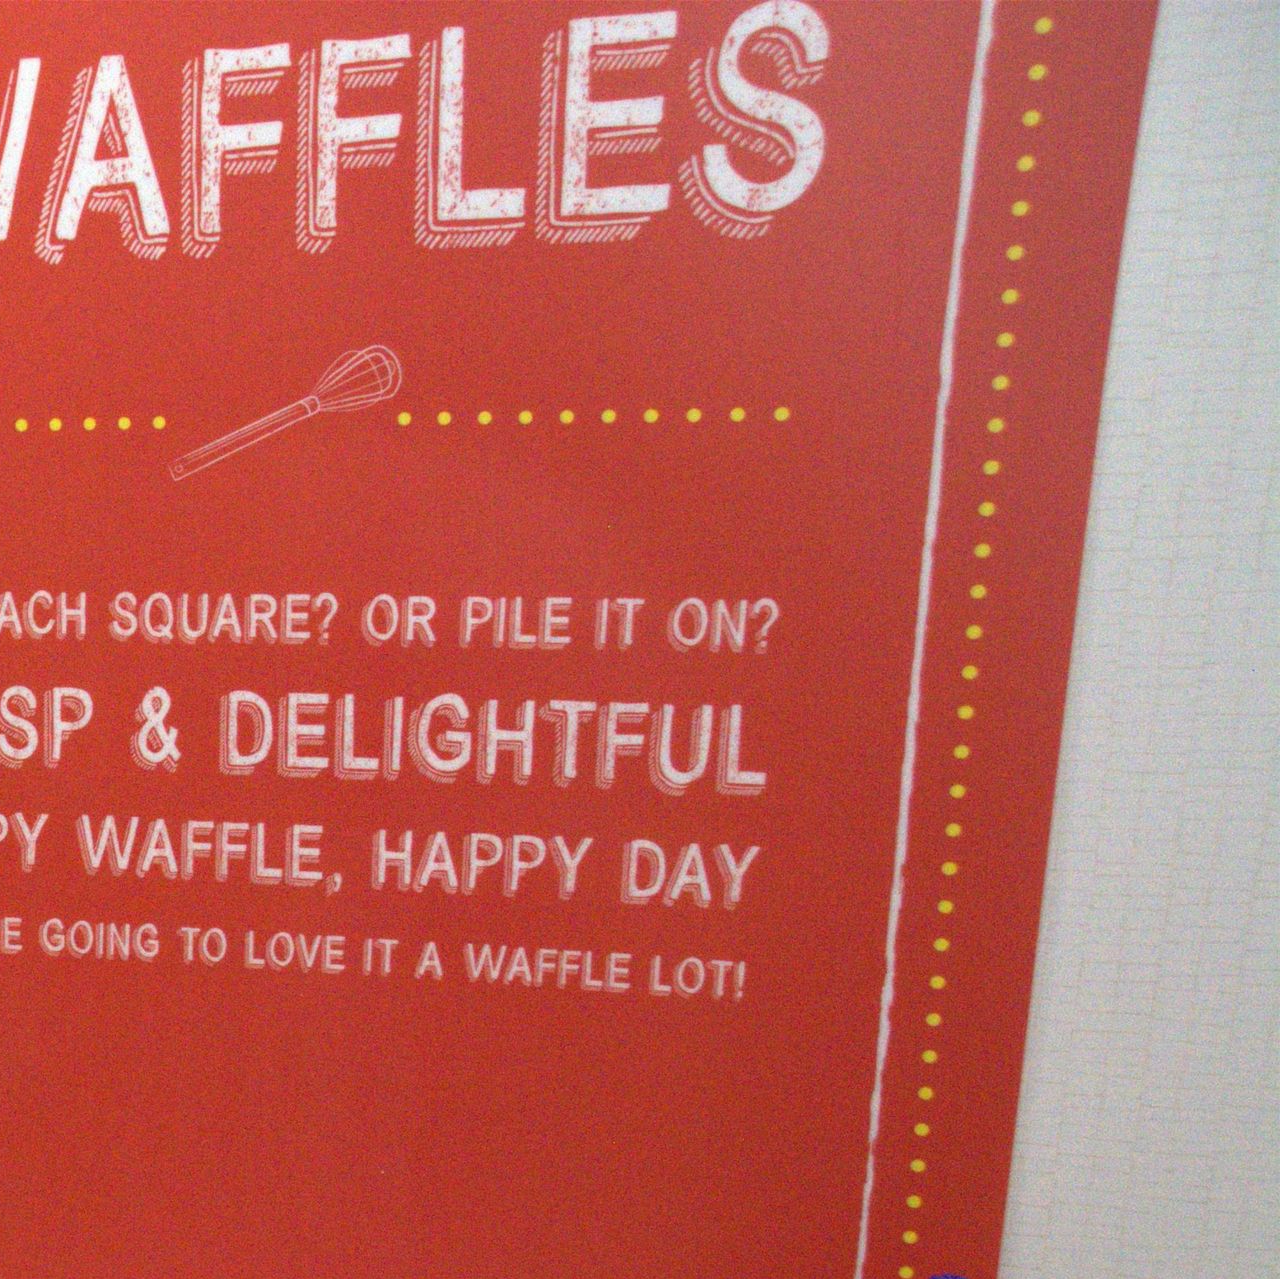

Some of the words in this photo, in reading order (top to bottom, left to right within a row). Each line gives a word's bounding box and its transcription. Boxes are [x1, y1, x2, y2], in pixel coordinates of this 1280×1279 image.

[110, 591, 338, 646] SQUARE?
[362, 594, 436, 648] OR
[459, 596, 571, 649] PILE
[595, 598, 645, 650] IT
[668, 598, 779, 654] ON?
[131, 686, 182, 773] &
[219, 690, 766, 796] DELIGHTFUL
[77, 814, 342, 898] WAFFLE,
[372, 829, 593, 901] HAPPY
[620, 839, 760, 910] DAY
[40, 918, 160, 961] GOING
[179, 926, 227, 969] TO
[243, 931, 345, 974] LOVE
[362, 938, 398, 976] IT
[415, 941, 443, 980] A
[464, 943, 632, 993] WAFFLE
[648, 954, 746, 1000] LOT!
